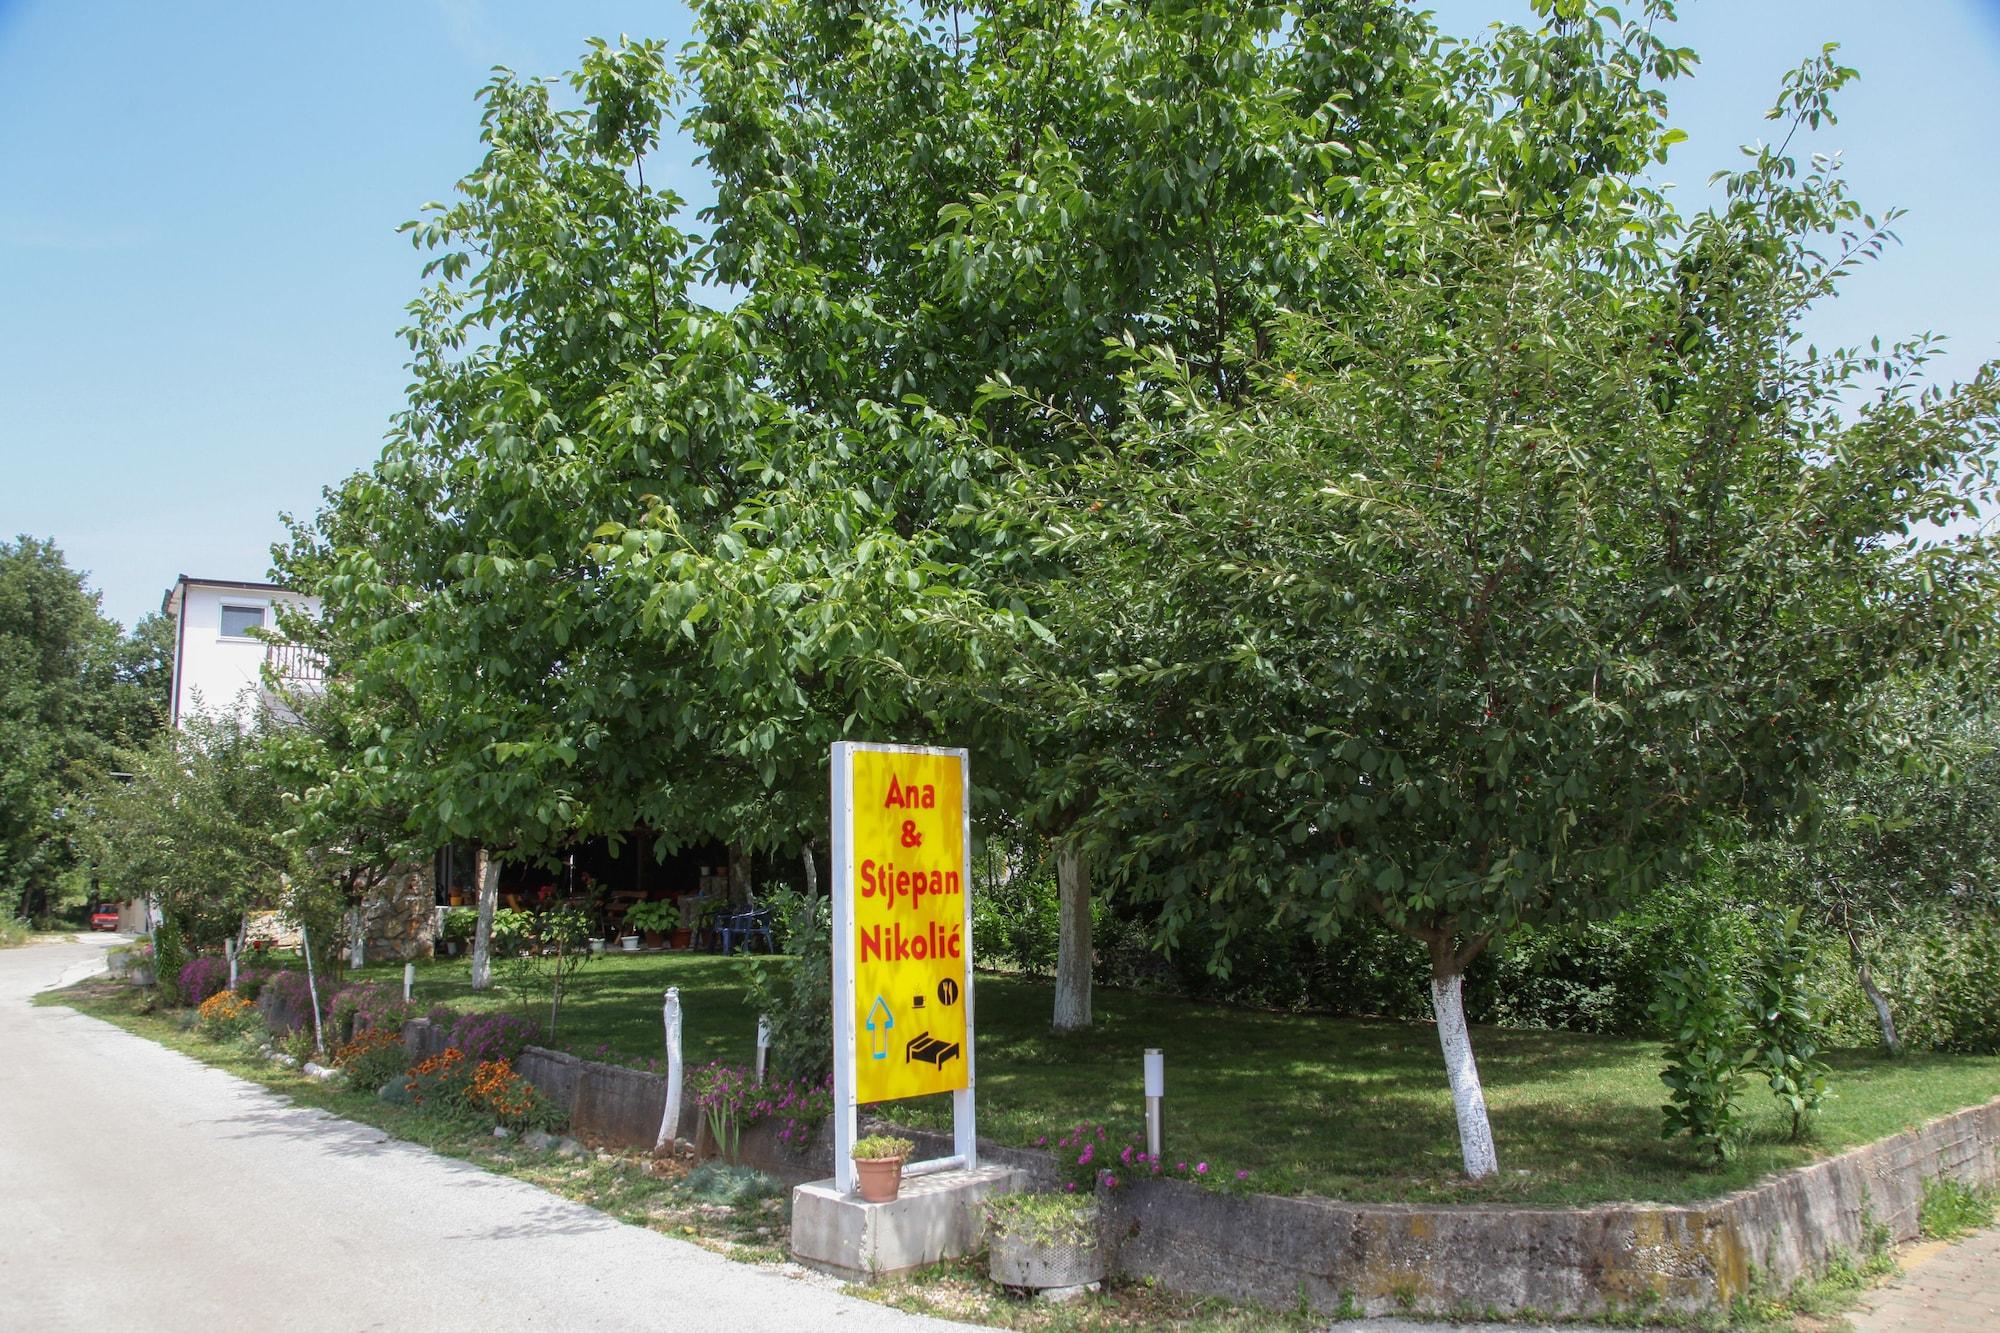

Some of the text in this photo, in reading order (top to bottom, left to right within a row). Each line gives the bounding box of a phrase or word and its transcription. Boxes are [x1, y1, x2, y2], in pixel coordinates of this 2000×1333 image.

[884, 774, 936, 810] Ana
[900, 819, 922, 849] &
[861, 859, 960, 910] Stjepan
[860, 921, 961, 963] Nikolić
